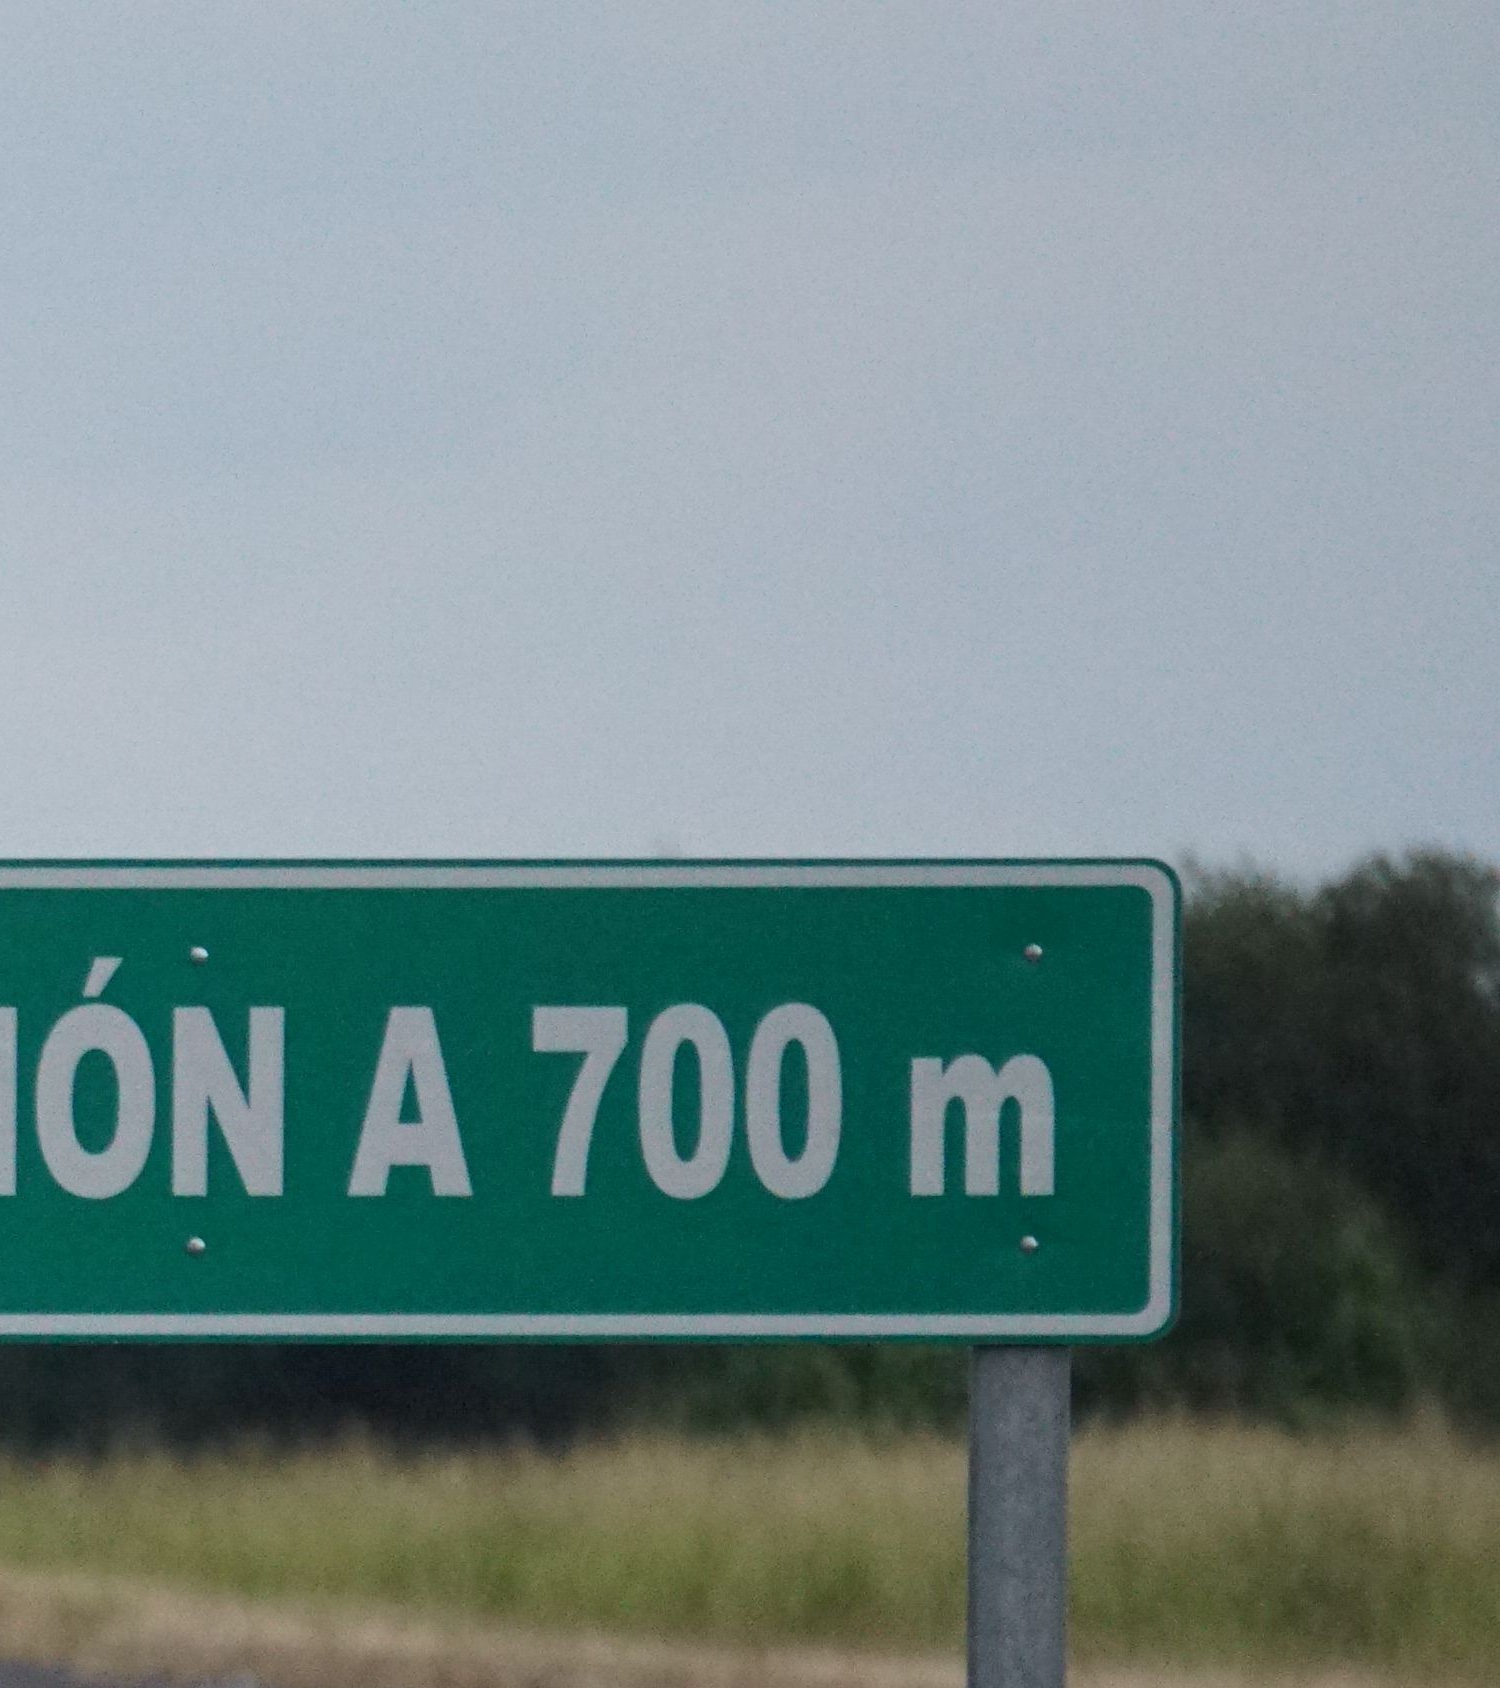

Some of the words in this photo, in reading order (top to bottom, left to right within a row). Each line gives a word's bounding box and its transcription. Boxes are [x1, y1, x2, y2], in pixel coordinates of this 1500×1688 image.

[347, 1005, 473, 1198] A
[531, 1003, 843, 1199] 700
[909, 1054, 1055, 1197] m
